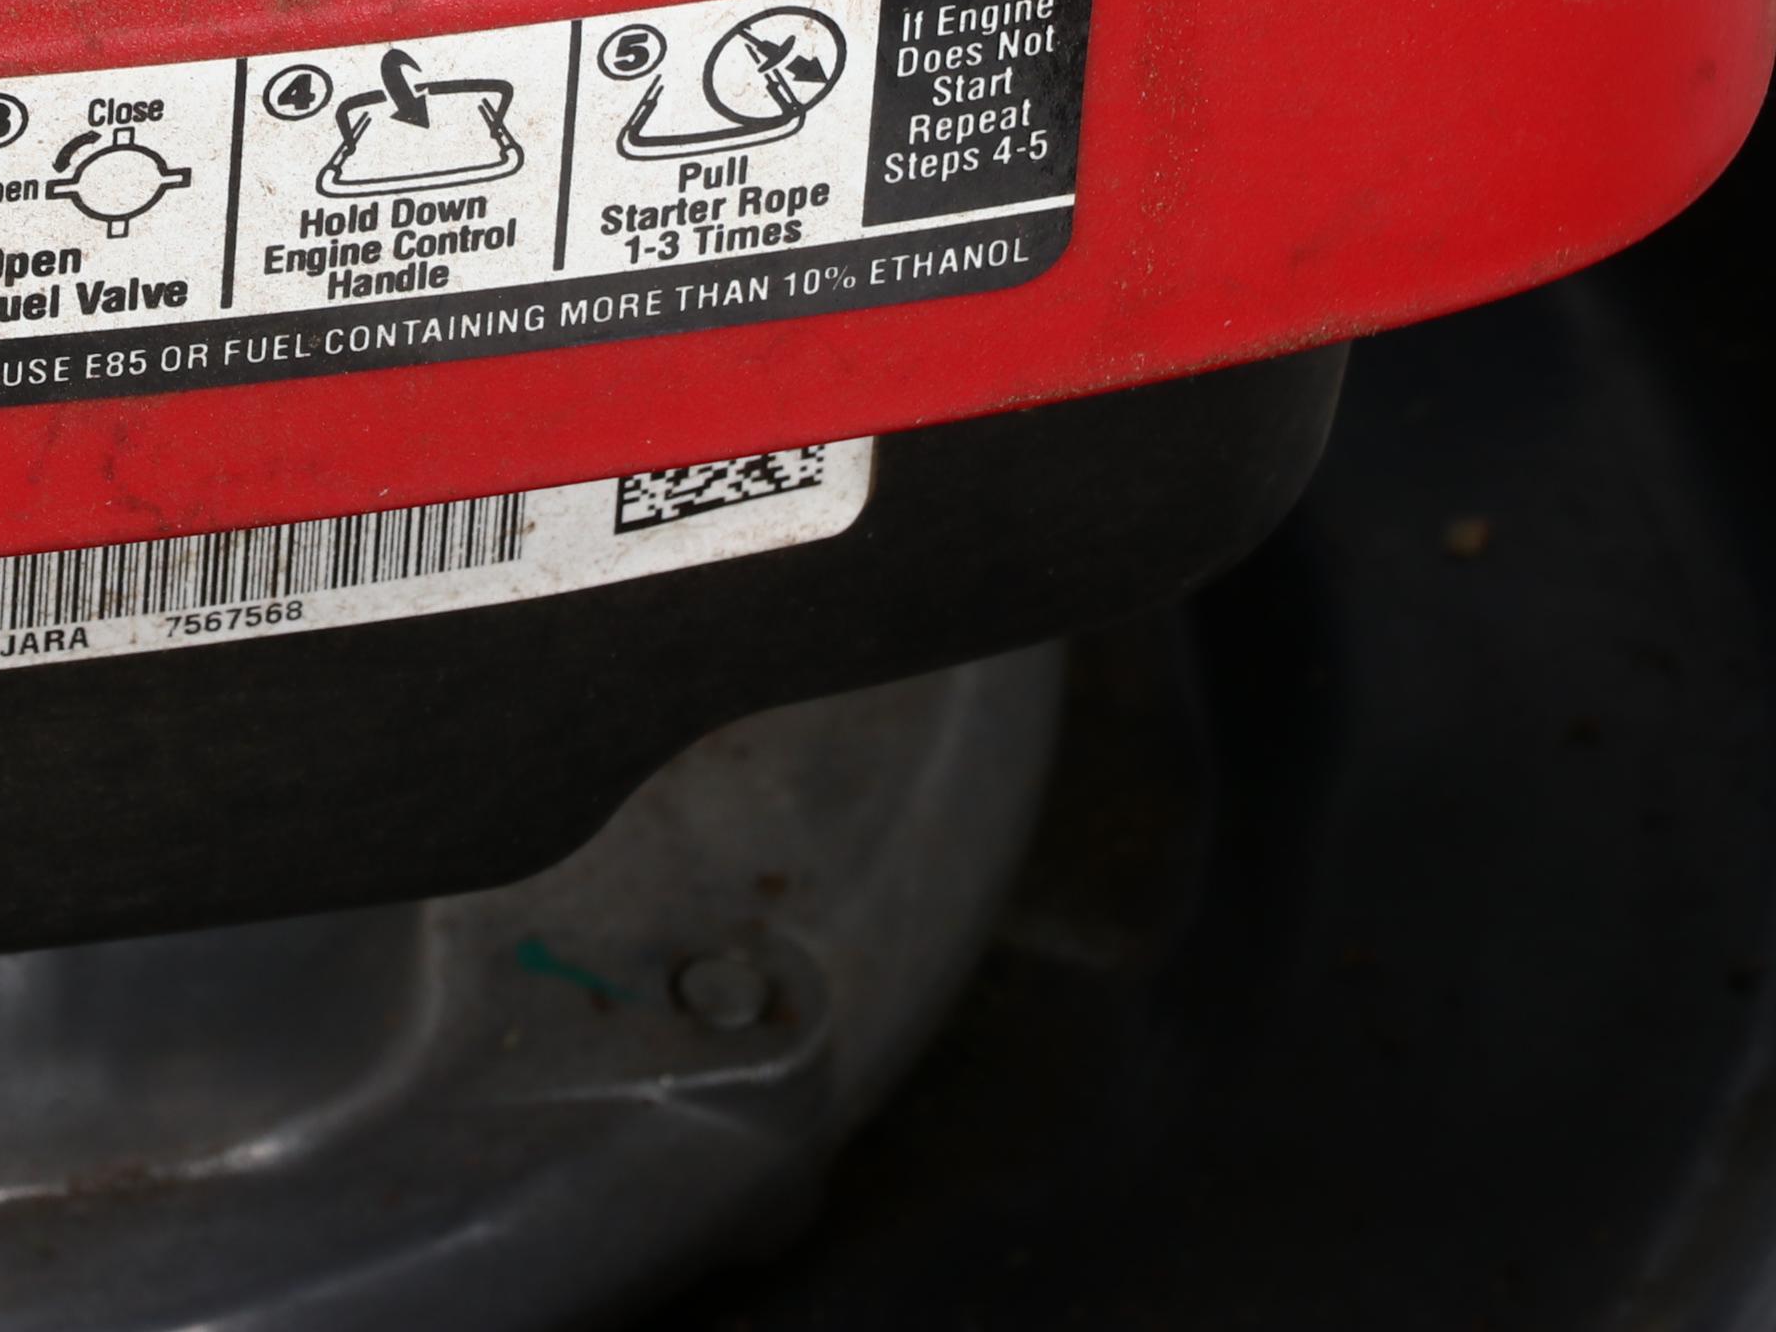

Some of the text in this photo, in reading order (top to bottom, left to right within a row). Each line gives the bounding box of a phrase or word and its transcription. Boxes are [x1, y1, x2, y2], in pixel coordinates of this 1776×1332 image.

[901, 10, 926, 42] If
[897, 24, 1055, 77] Does Not
[932, 66, 1013, 105] Start
[87, 98, 164, 125] Close
[909, 98, 1032, 145] Repeat
[678, 156, 749, 192] Pull
[884, 130, 1049, 184] Steps 4-5
[300, 194, 487, 239] Hold Down
[600, 181, 831, 236] Starter Rope
[264, 219, 517, 277] Engine Control
[625, 219, 803, 265] 1-3 Times
[77, 277, 189, 315] Valve
[328, 262, 450, 300] Handle
[2, 355, 71, 387] USE
[85, 351, 148, 379] E85
[160, 342, 209, 372] OR
[224, 335, 311, 363] FUEL
[324, 306, 545, 354] CONTAINING
[560, 288, 663, 327] MORE
[675, 275, 770, 315] THAN
[783, 266, 856, 299] 10%
[869, 237, 1030, 285] ETHANOL
[164, 599, 305, 639] 7567568
